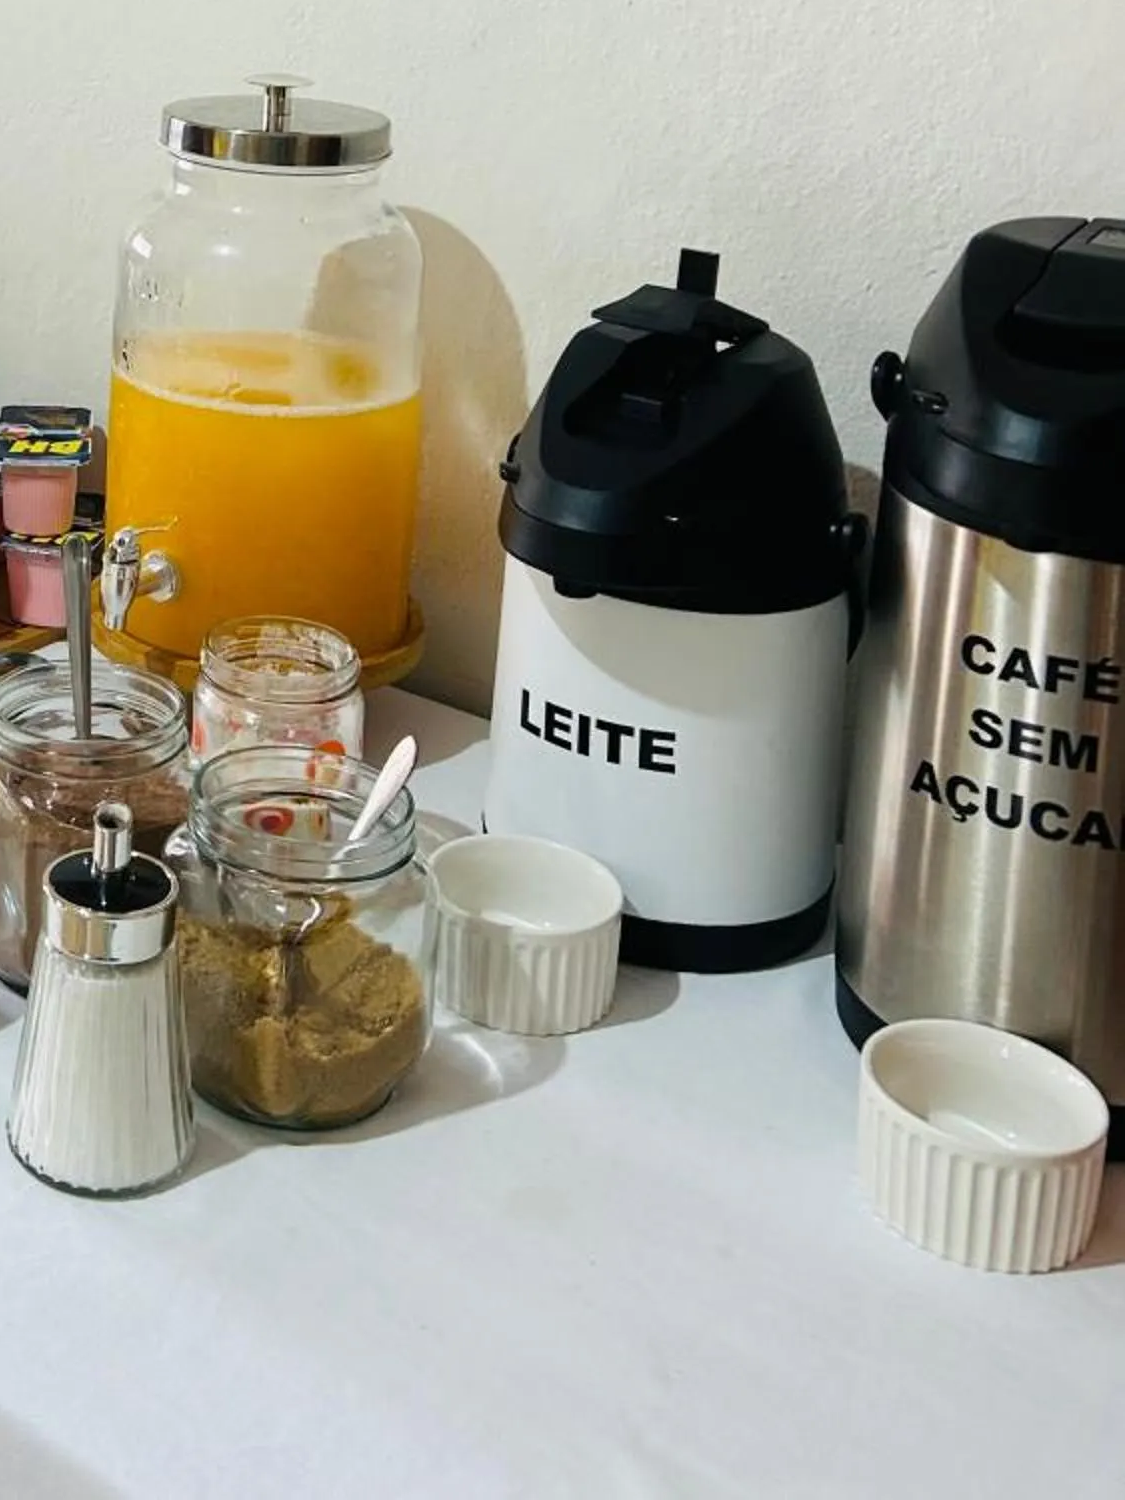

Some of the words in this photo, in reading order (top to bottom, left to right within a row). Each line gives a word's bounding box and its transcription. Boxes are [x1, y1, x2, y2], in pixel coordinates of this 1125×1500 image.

[961, 635, 1121, 704] CAFÉ
[520, 689, 677, 774] LEITE
[969, 709, 1098, 773] SEM
[910, 760, 1125, 852] AÇUCA
